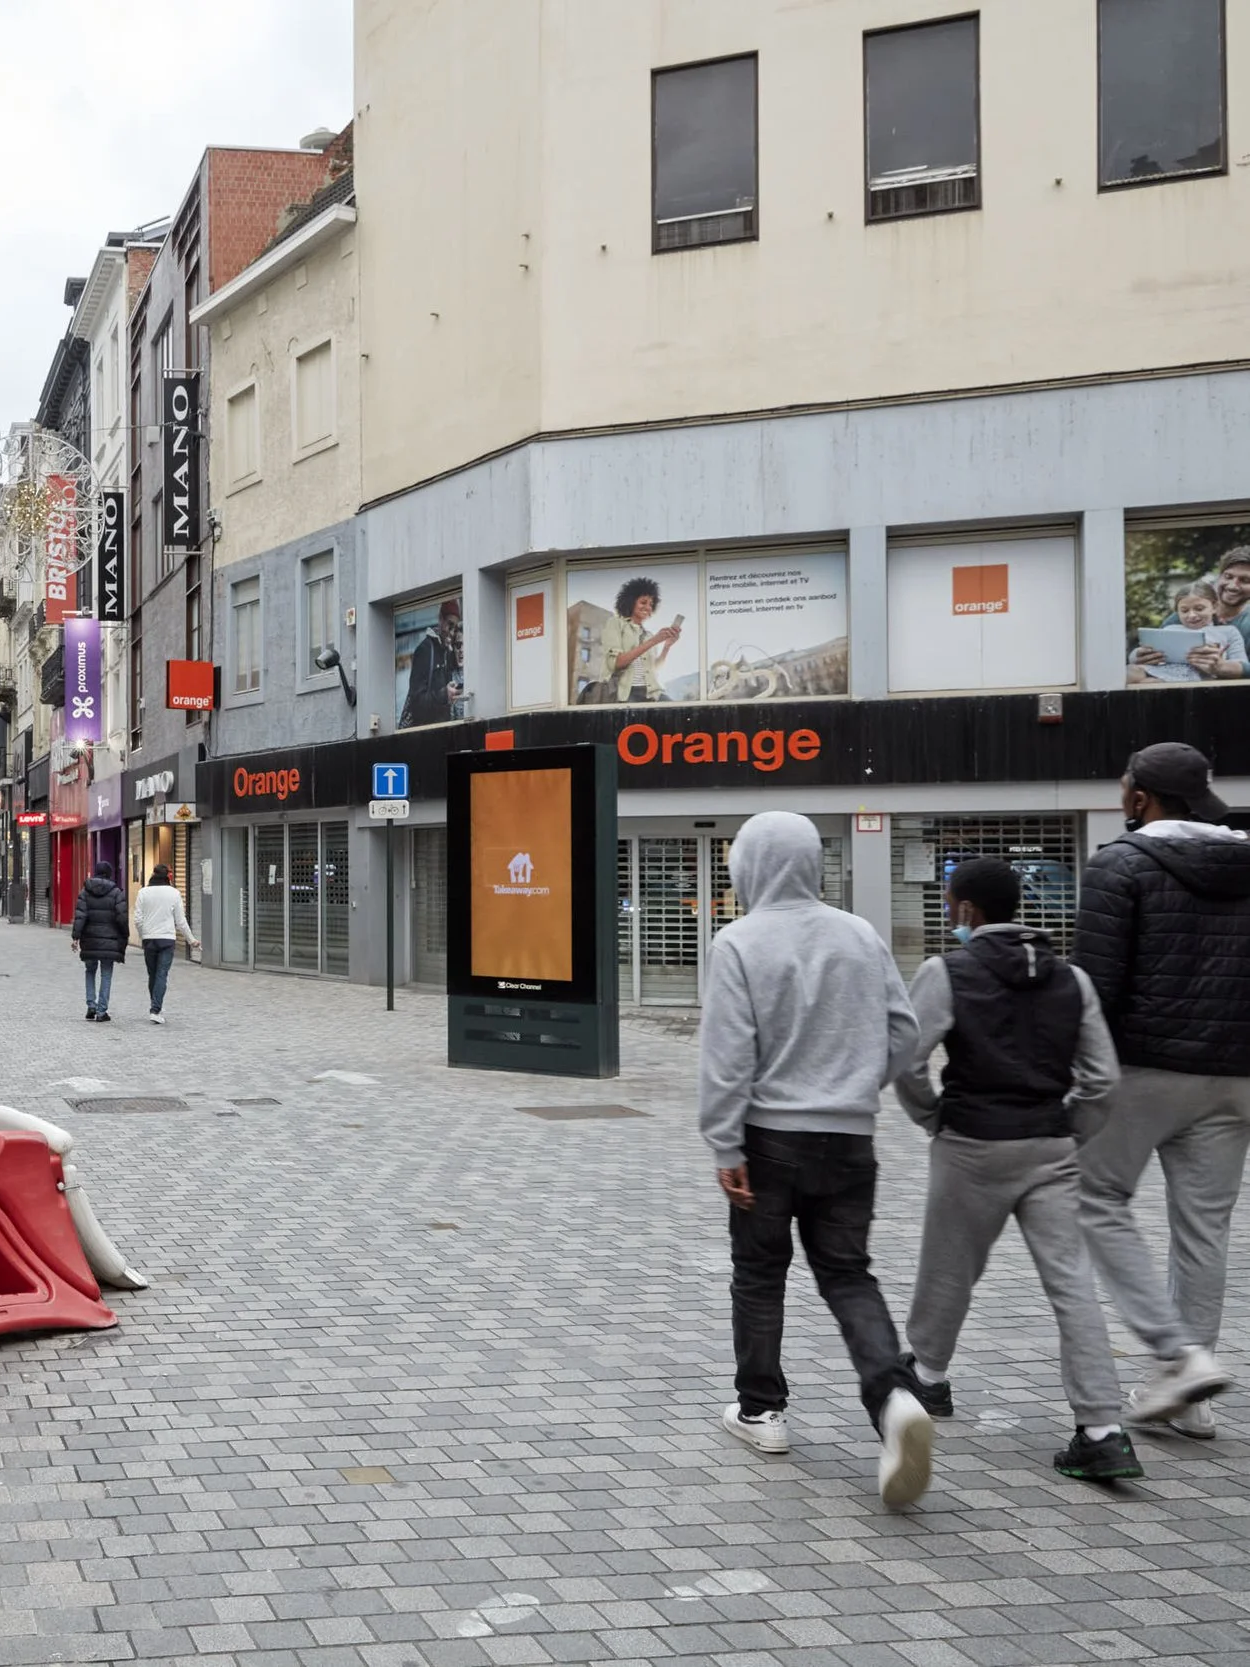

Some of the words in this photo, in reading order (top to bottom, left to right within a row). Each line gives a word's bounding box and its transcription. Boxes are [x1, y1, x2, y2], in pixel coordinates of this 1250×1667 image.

[172, 385, 190, 538] MANO
[105, 498, 118, 615] MANO
[710, 574, 738, 582] Rentrez
[748, 571, 786, 579] découvrez
[710, 582, 731, 590] offres
[955, 600, 1005, 613] orange
[517, 625, 543, 638] orange
[78, 641, 87, 693] proximus
[173, 696, 209, 708] orange
[618, 724, 821, 772] Orange
[234, 767, 301, 800] Orange
[493, 884, 550, 896] Takeaway.com
